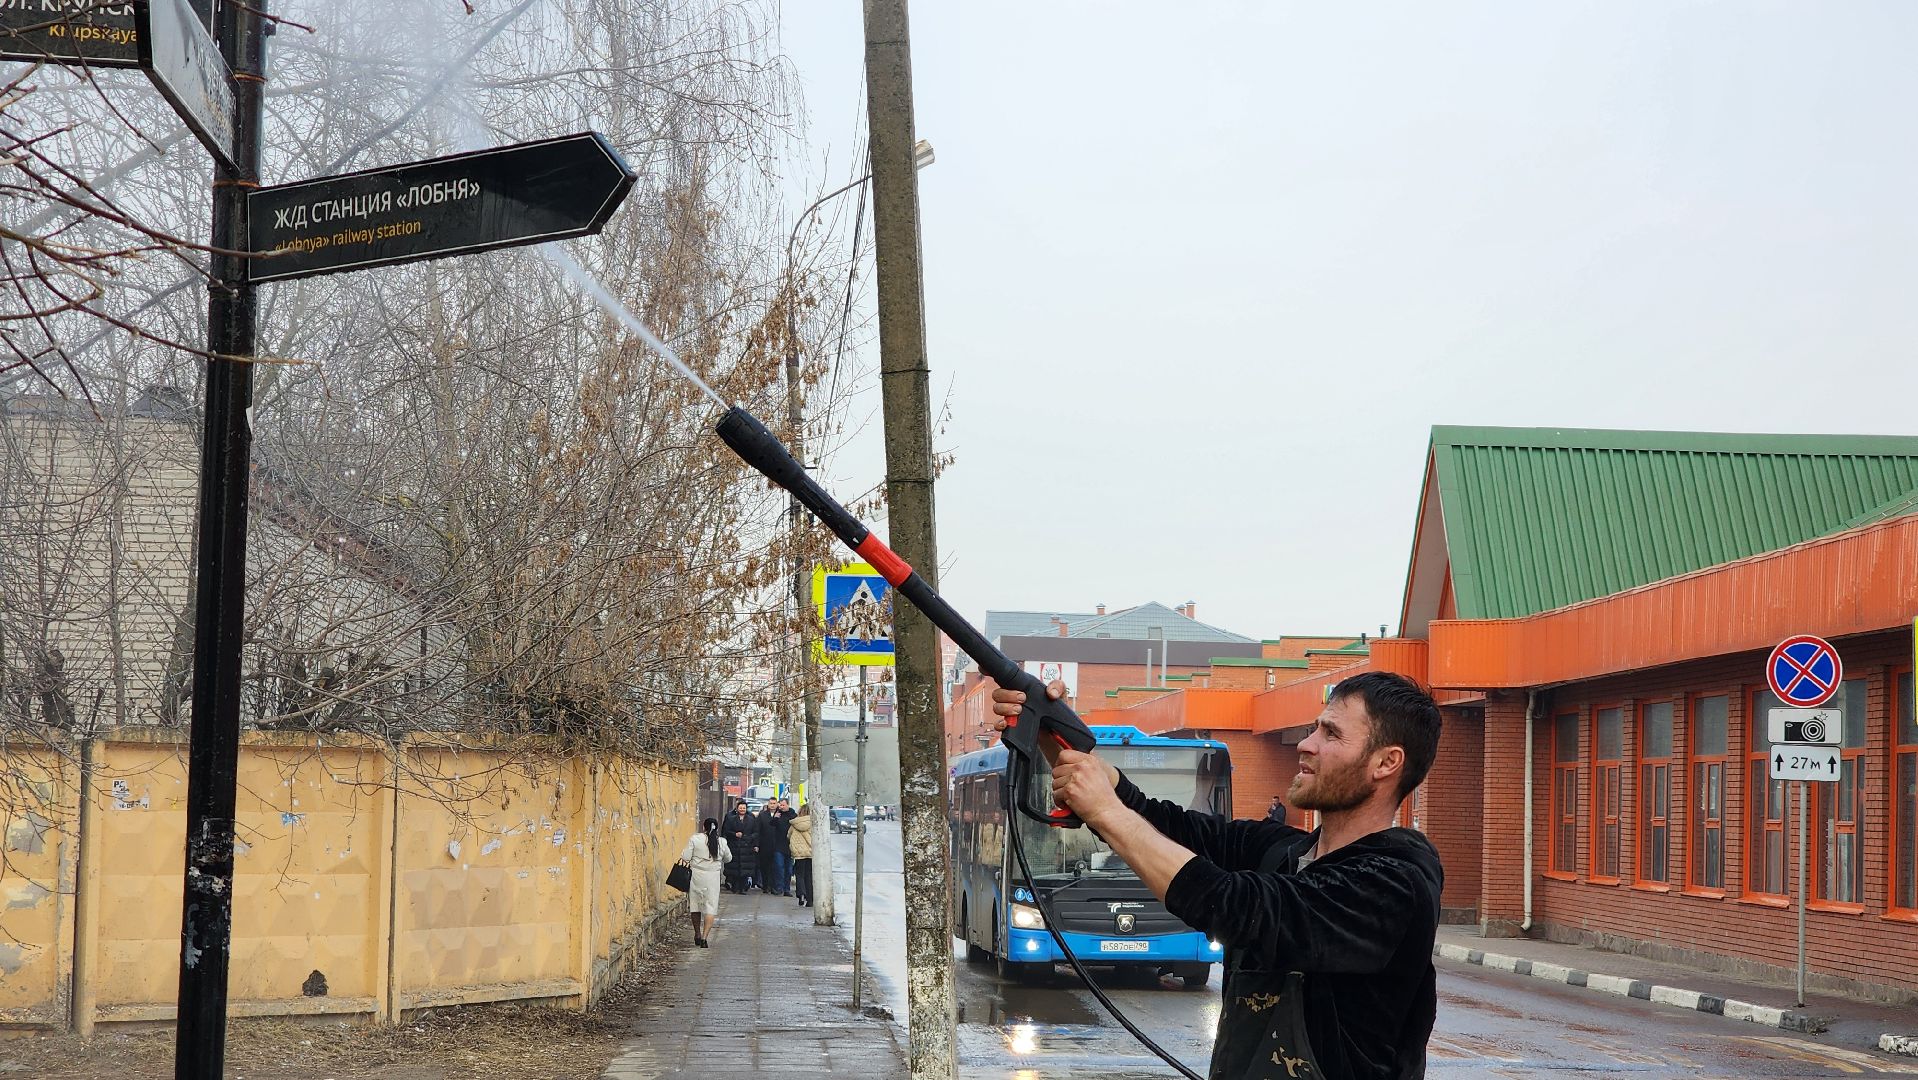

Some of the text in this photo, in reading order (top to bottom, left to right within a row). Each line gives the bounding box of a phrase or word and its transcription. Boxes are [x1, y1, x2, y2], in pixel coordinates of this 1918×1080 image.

[273, 178, 480, 230] Ж/Д СТАНЦИЯ «ЛОБНЯ»
[332, 228, 375, 245] railway
[377, 220, 421, 239] station
